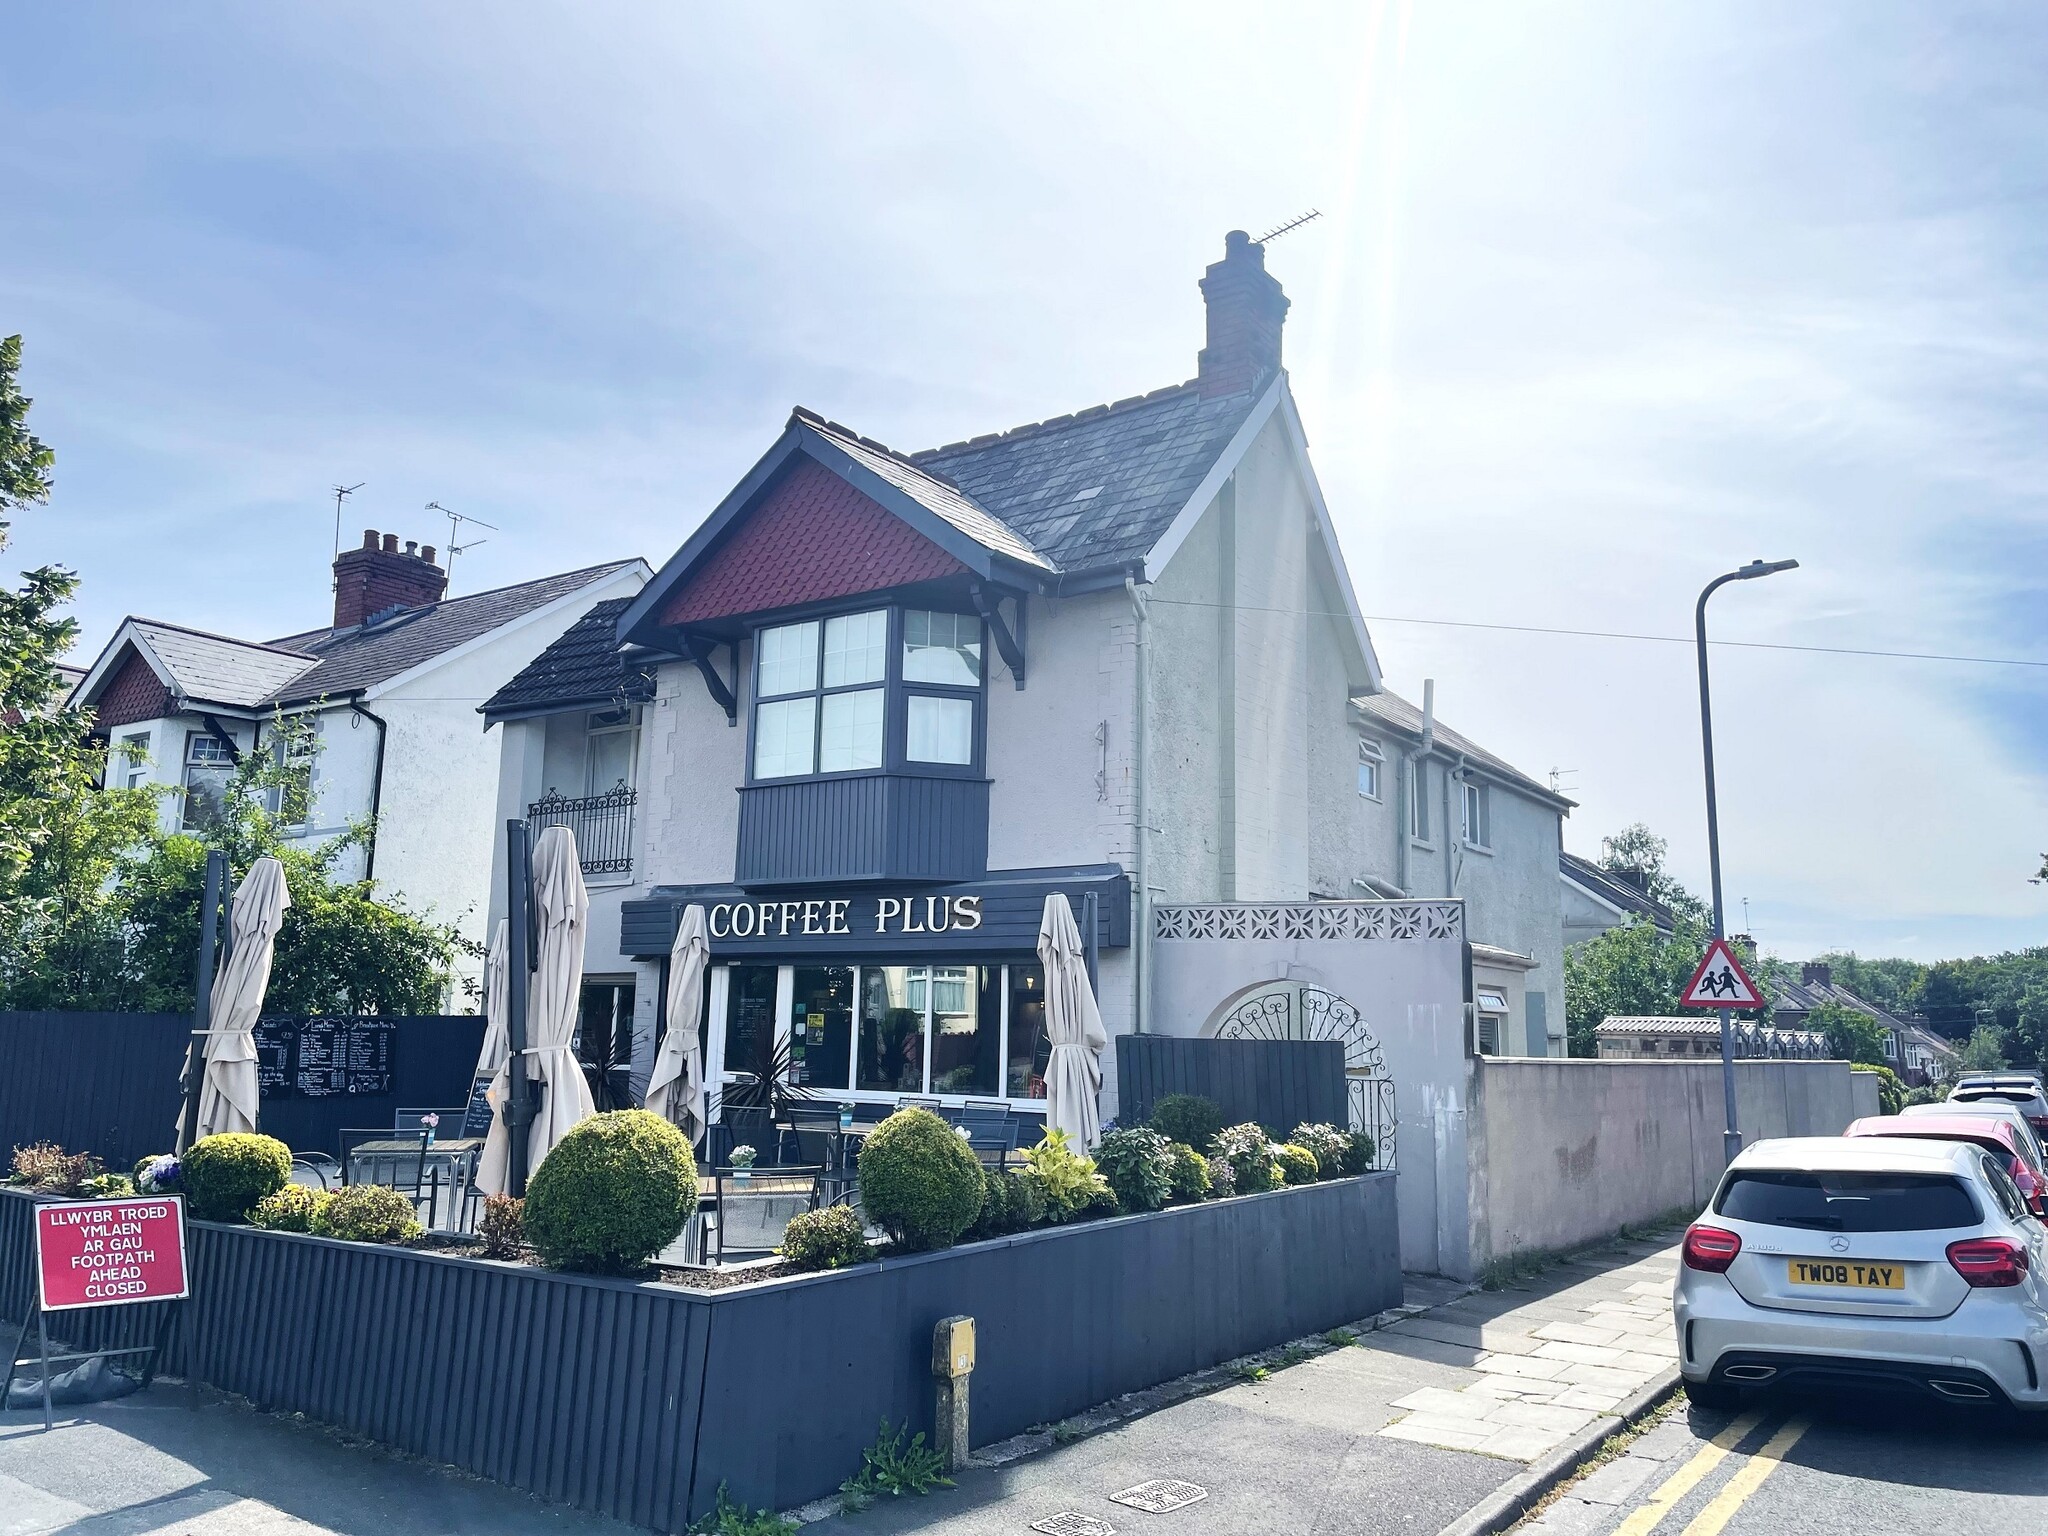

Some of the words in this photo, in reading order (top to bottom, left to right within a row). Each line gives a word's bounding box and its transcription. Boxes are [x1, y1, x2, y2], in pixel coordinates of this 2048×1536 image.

[709, 899, 851, 938] COFFEE
[874, 895, 982, 933] PLUS
[50, 1209, 113, 1226] LLWYBR
[118, 1206, 168, 1221] TROED
[80, 1222, 142, 1238] YMLAEN
[83, 1240, 104, 1253] AR
[110, 1237, 142, 1250] GAU
[71, 1250, 155, 1269] FOOTPATH
[89, 1266, 141, 1283] AHEAD
[1797, 1263, 1848, 1284] TW08
[1853, 1266, 1892, 1286] TAY
[85, 1280, 147, 1298] CLOSED
